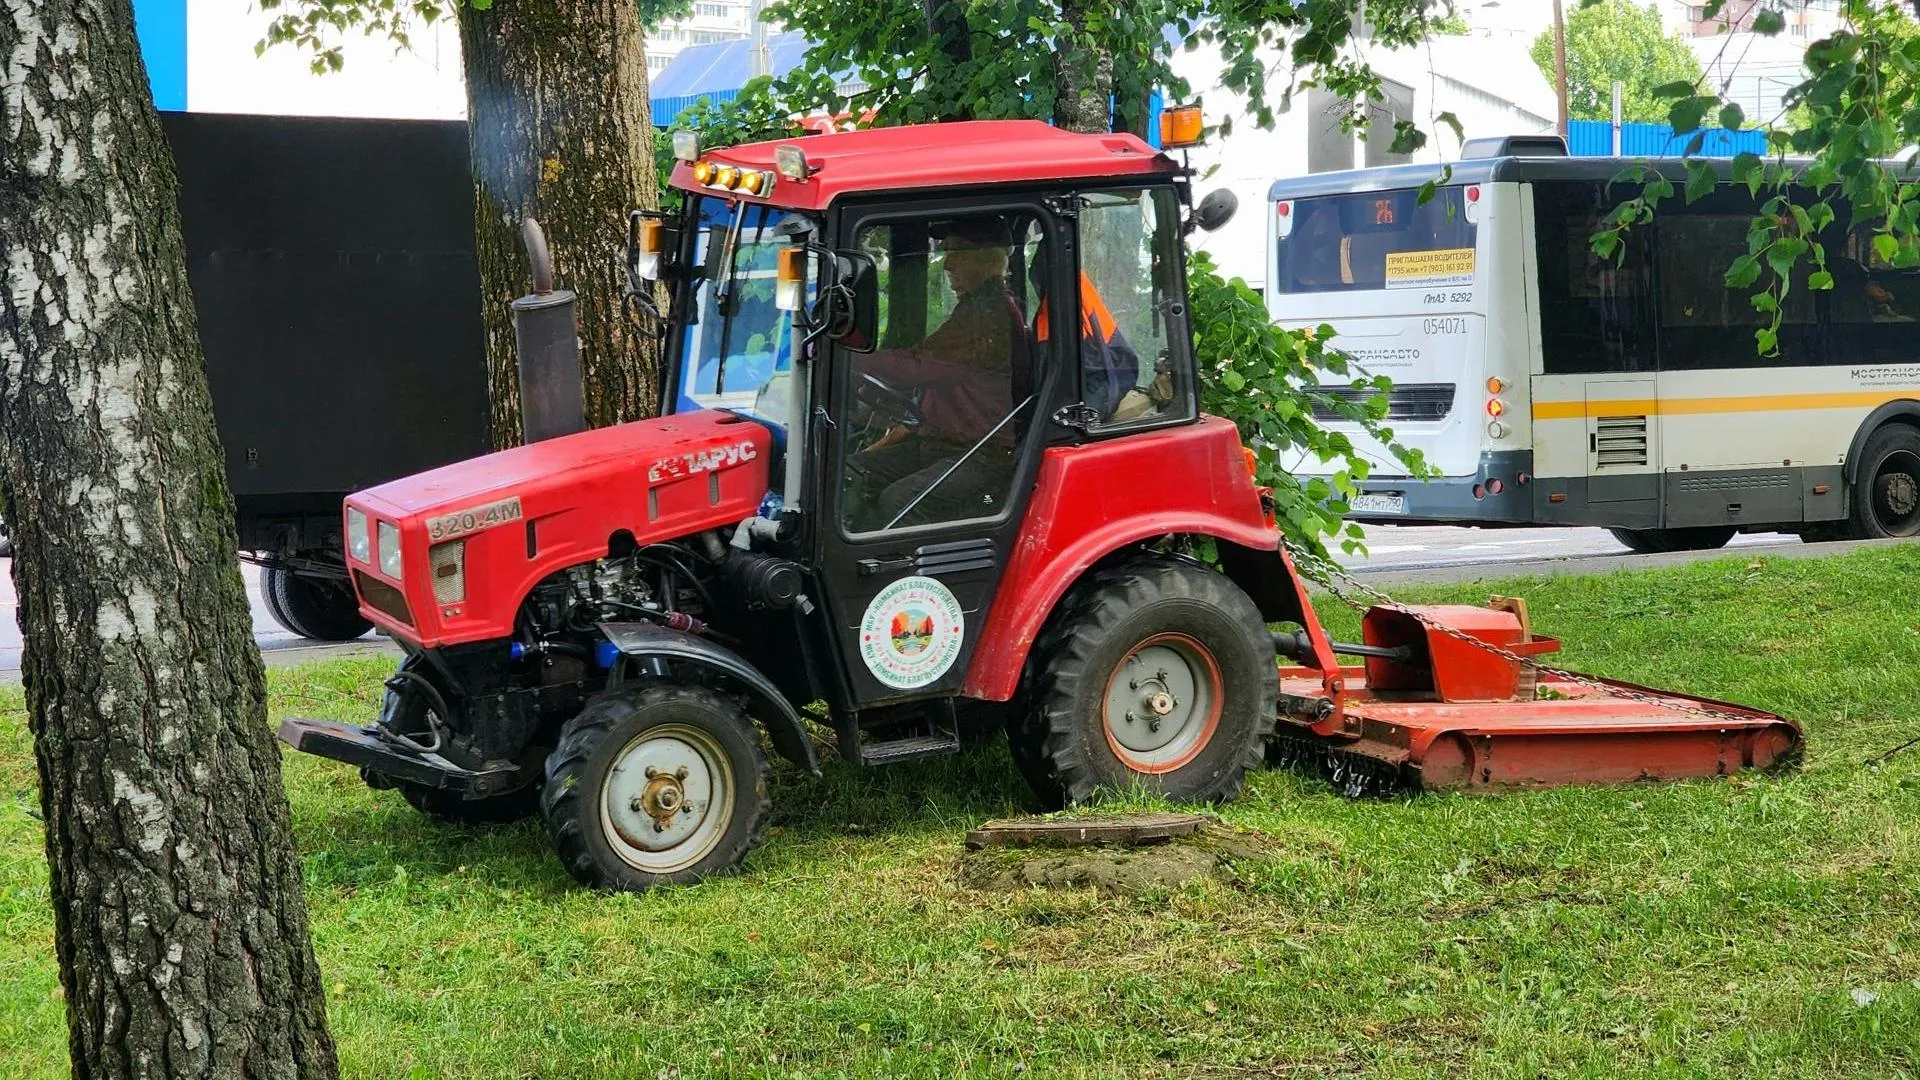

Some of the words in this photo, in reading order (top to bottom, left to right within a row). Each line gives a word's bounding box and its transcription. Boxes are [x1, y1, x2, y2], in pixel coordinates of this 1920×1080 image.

[1388, 255, 1434, 264] ПРИГЛАШАЕМ
[1434, 250, 1473, 260] ВОДИТЕЛЕЙ
[1450, 292, 1473, 303] 5292
[1423, 317, 1467, 335] 054071
